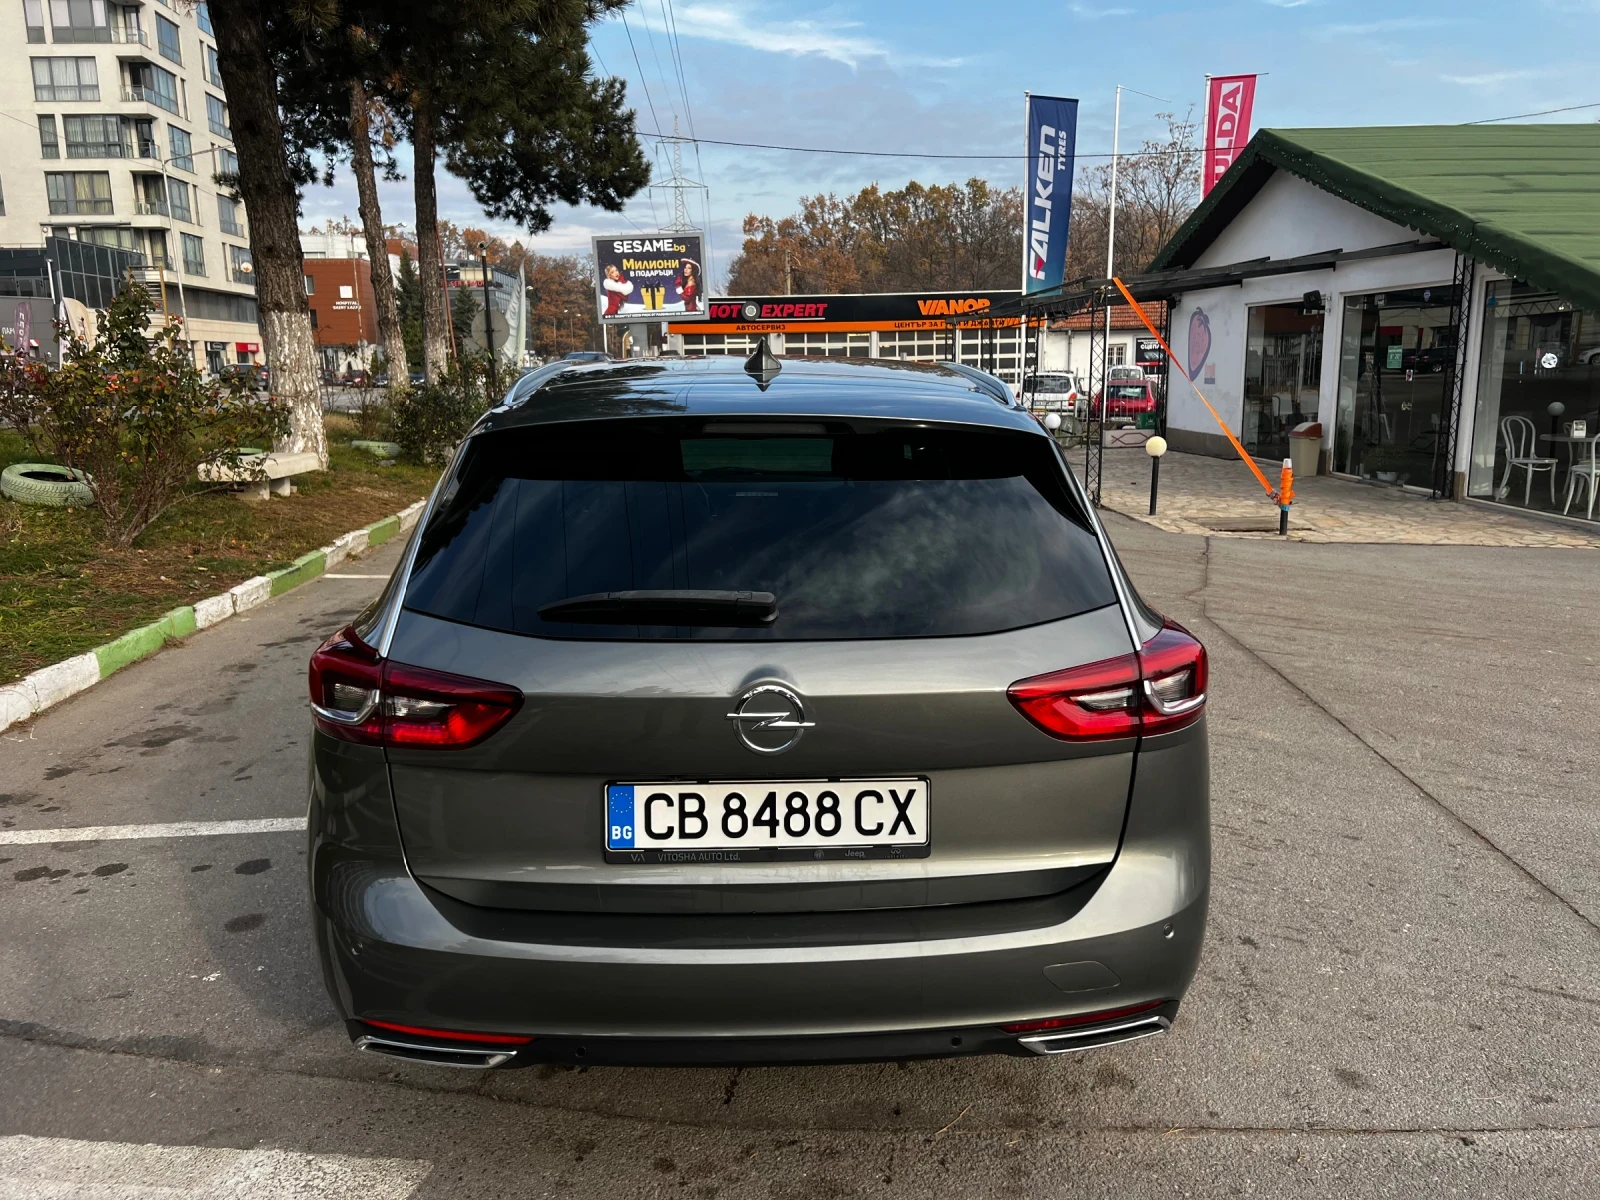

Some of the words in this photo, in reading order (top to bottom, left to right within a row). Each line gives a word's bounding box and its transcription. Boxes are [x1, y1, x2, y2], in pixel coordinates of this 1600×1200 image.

[1214, 84, 1241, 182] ULDA
[1057, 130, 1067, 171] TYRES
[1029, 124, 1056, 280] FALKEN
[613, 239, 686, 253] SESAME.bg
[635, 269, 674, 278] ПОДАРЪЦИ
[760, 303, 828, 317] EXPERT
[916, 298, 991, 316] VIANOR
[894, 321, 927, 329] ЦЕНТЪР
[644, 792, 708, 840] CB
[721, 790, 842, 838] 8488
[854, 789, 917, 836] CX
[611, 825, 633, 840] BG
[658, 853, 696, 862] VITOSHA
[698, 852, 723, 861] AUTO
[724, 851, 741, 861] Ltd.
[844, 849, 865, 859] Jeep
